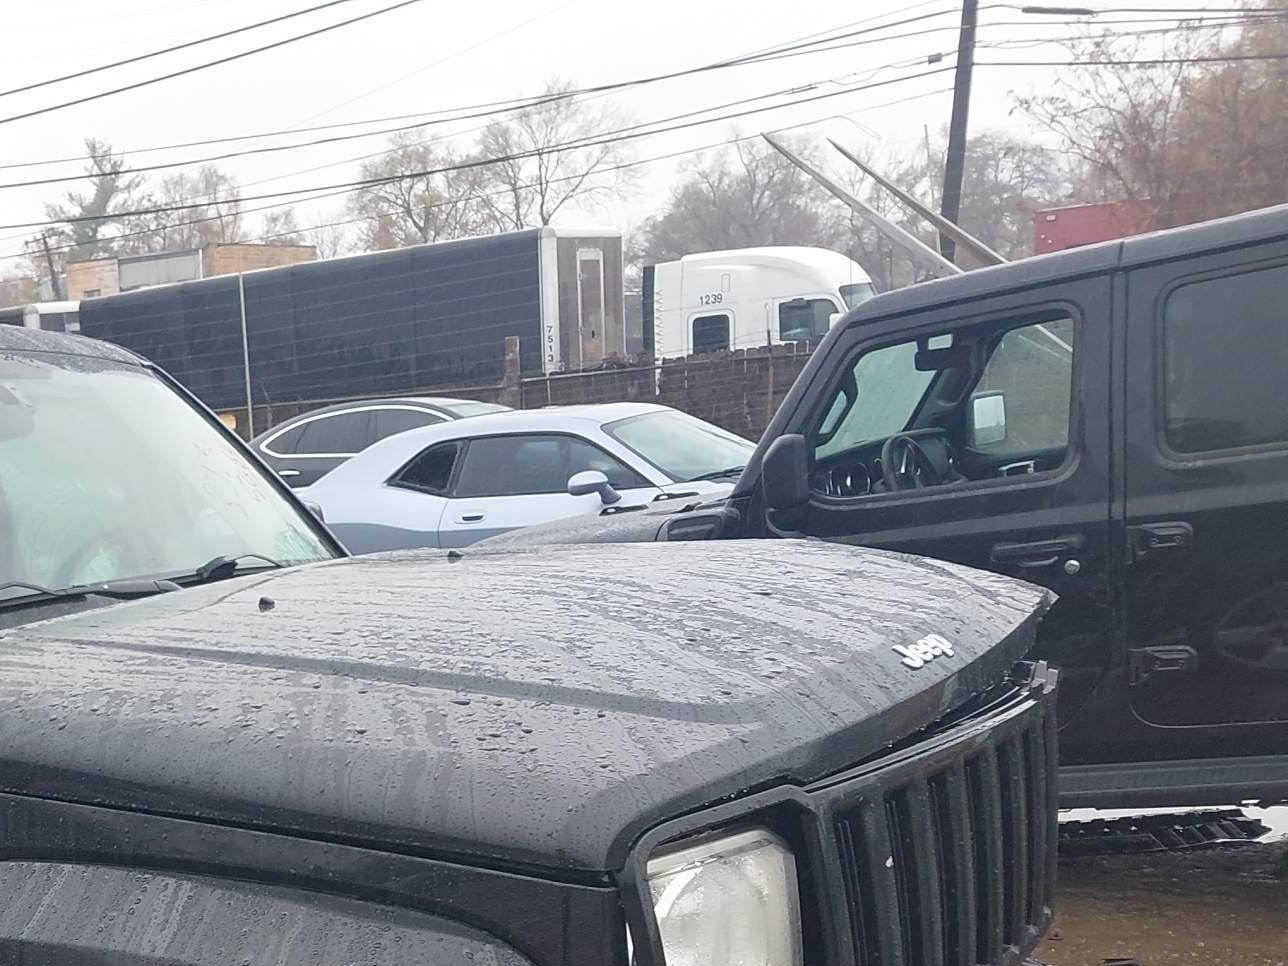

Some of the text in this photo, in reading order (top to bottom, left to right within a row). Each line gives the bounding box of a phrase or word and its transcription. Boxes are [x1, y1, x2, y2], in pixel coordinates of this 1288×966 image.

[699, 293, 723, 305] 1239
[545, 324, 555, 363] 7513
[891, 633, 954, 669] Jeep
